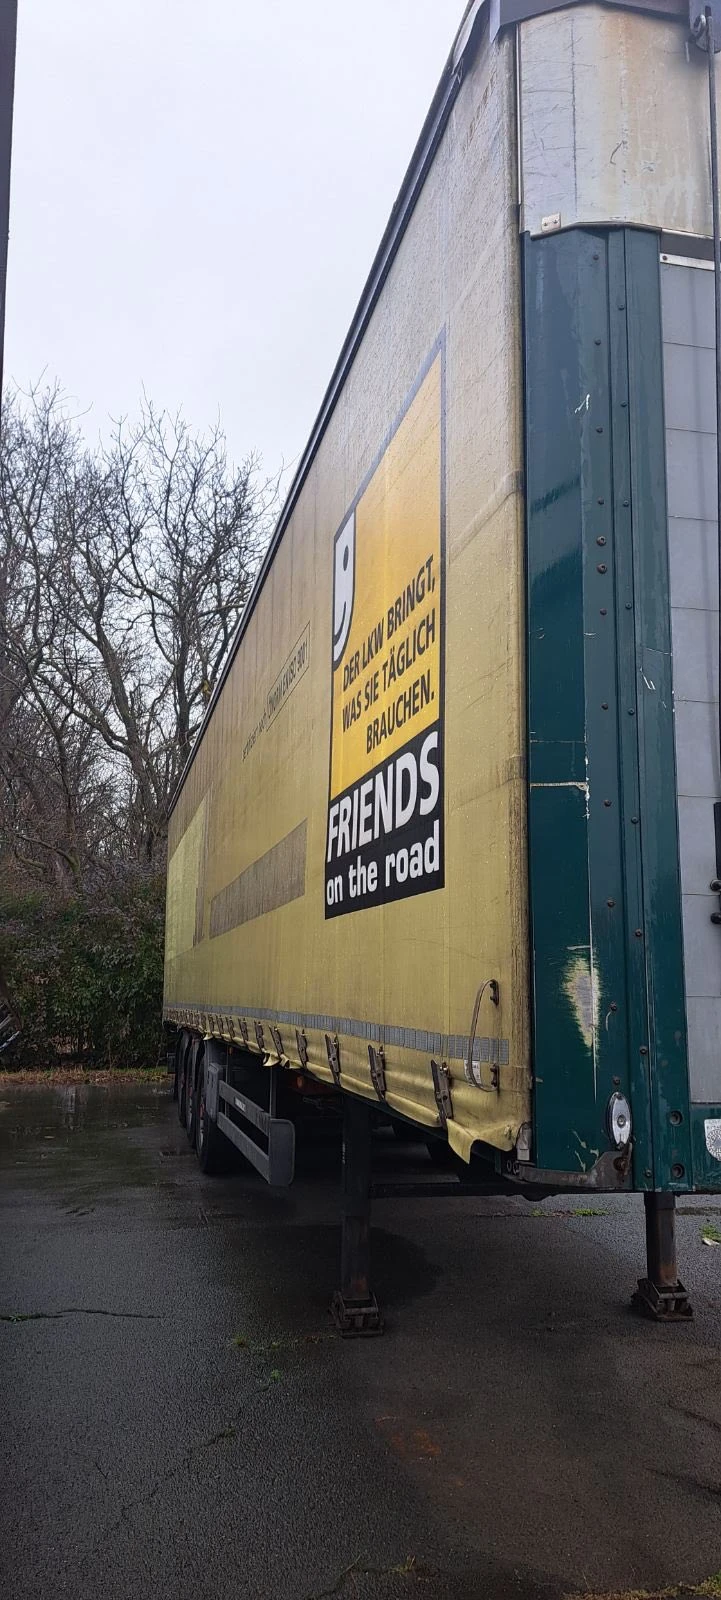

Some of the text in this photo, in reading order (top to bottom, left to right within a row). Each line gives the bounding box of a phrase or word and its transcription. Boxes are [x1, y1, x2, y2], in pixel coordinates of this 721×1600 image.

[342, 607, 435, 733] WAS SIE TÄGLICH
[343, 553, 435, 692] DER LKW BRINGT,
[366, 669, 435, 754] BRAUCHEN.
[327, 730, 440, 863] FRIENDS
[326, 819, 440, 906] on the road
